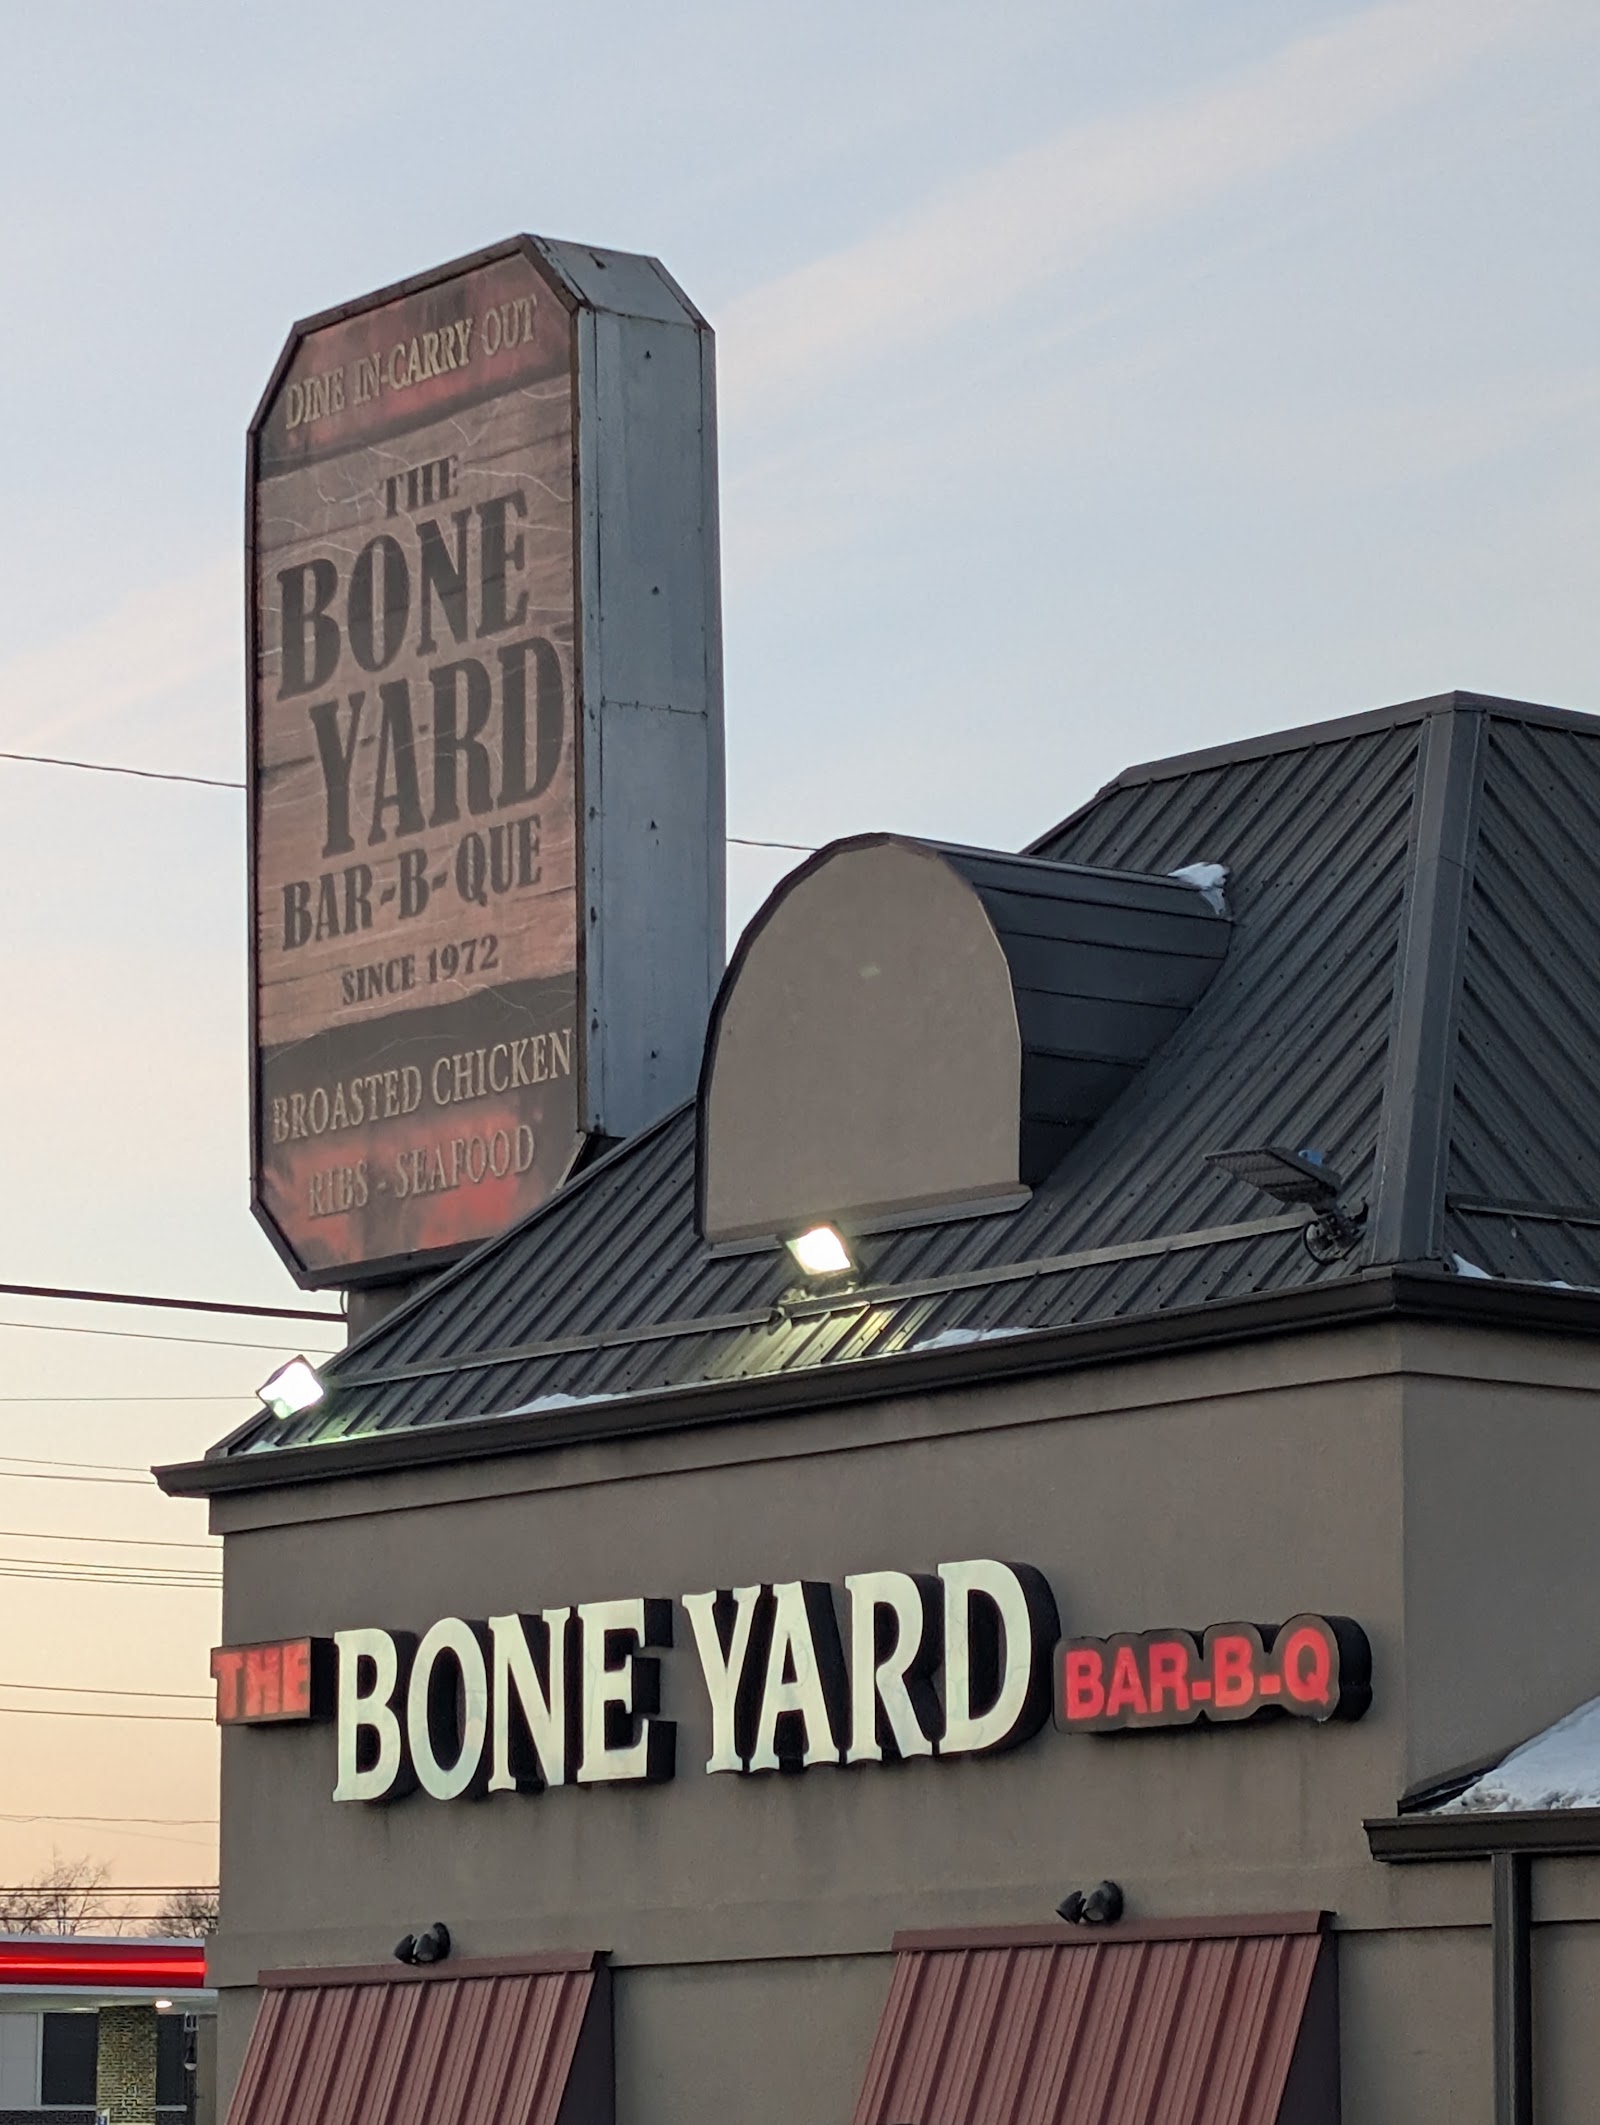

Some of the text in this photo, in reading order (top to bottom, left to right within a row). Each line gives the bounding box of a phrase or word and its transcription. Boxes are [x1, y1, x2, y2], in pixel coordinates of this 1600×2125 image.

[286, 367, 345, 430] DINE
[483, 297, 537, 356] OUT
[380, 455, 459, 519] THE
[277, 489, 529, 700] BONE
[308, 636, 564, 858] YARD
[281, 814, 543, 951] BAR-B-QUE
[342, 934, 499, 1005] SINCE 1972
[272, 1028, 574, 1144] BROASTED CHICKEN
[308, 1159, 370, 1218] RIBS
[395, 1124, 536, 1200] SEAFOOD
[214, 1558, 1331, 1802] THE BONE YARD BAR-B-Q
